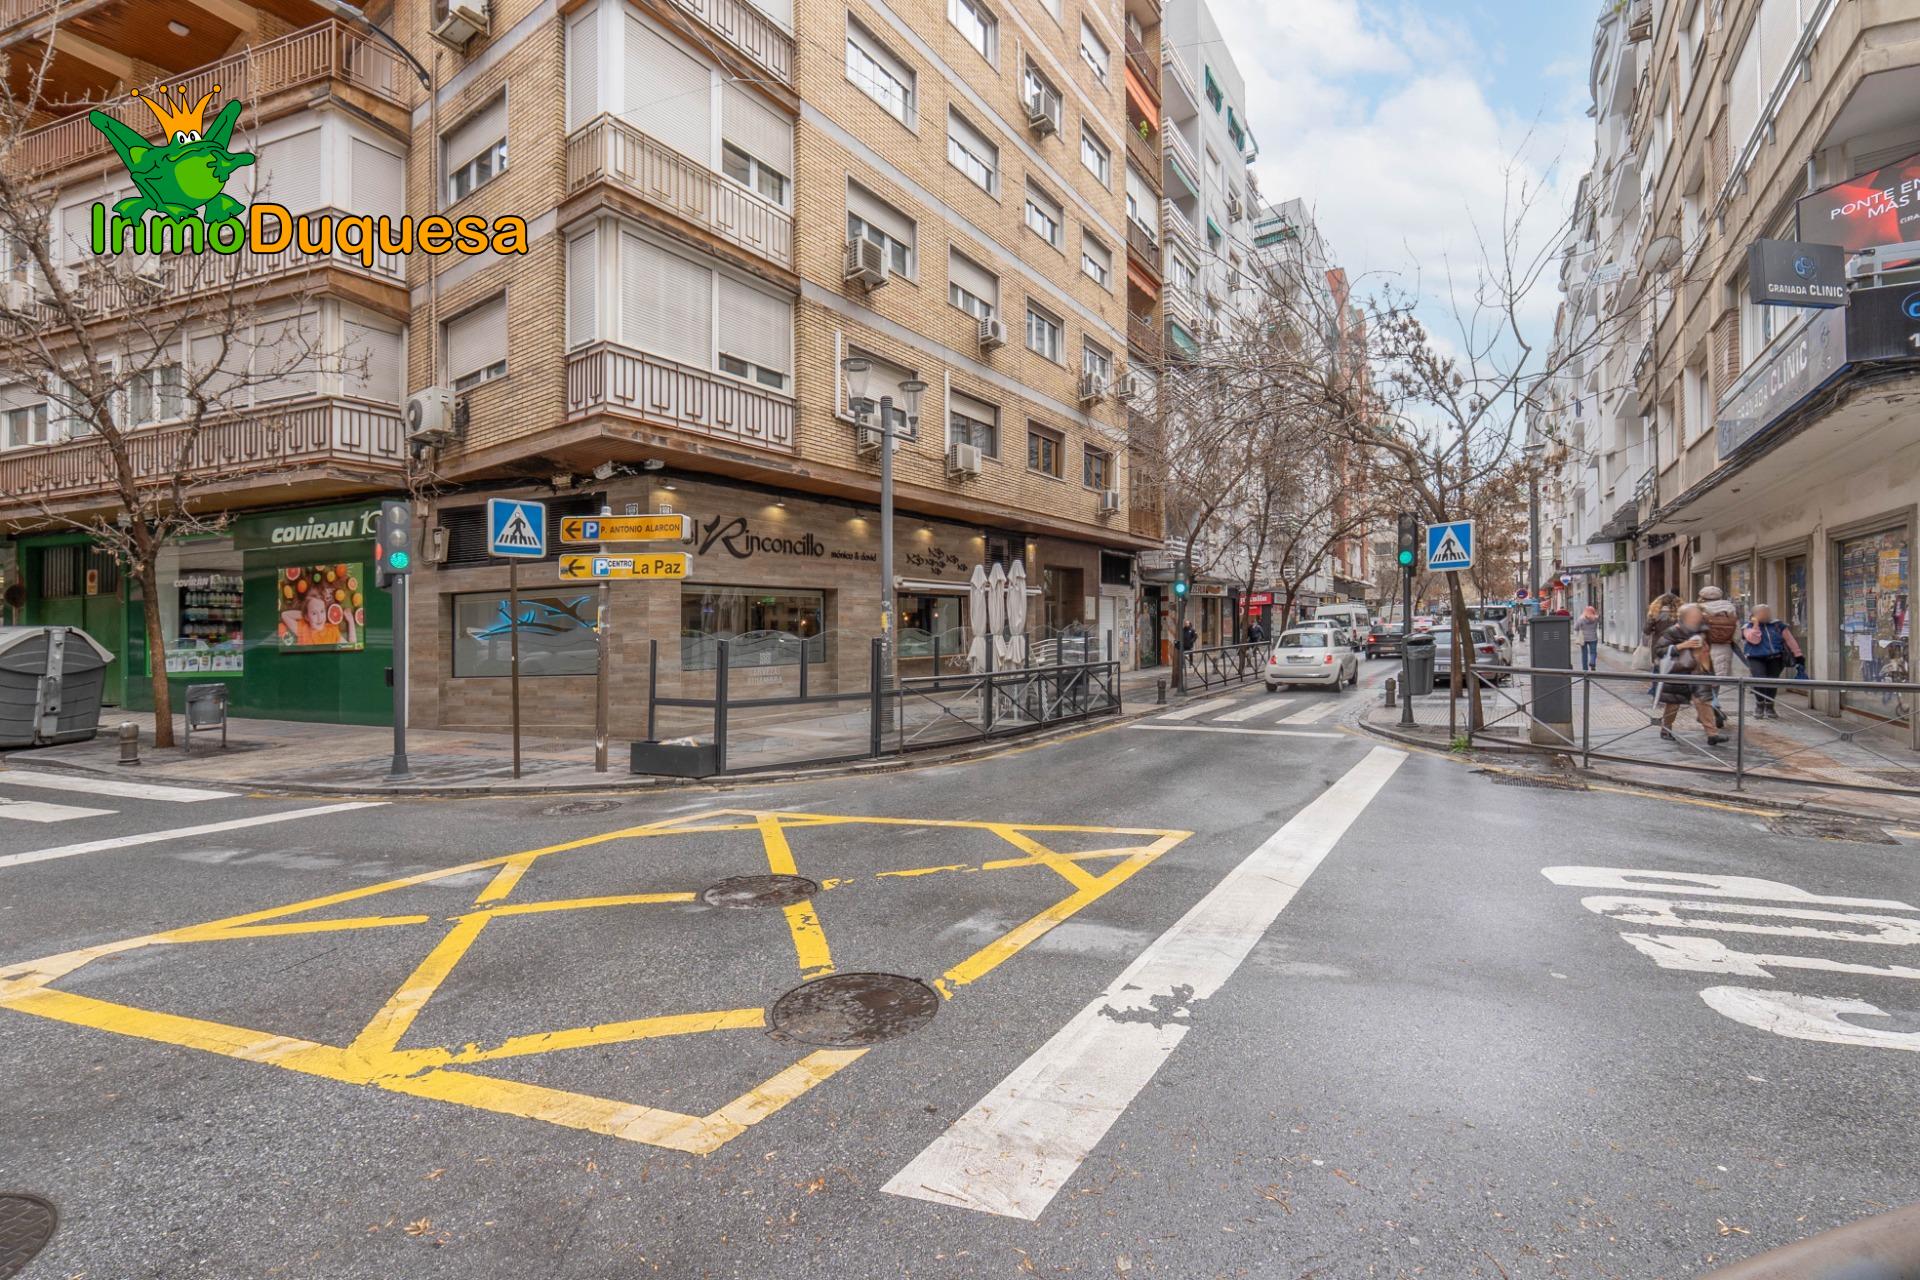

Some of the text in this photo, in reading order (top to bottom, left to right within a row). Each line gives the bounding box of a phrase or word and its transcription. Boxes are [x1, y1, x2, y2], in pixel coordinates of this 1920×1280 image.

[1830, 187, 1895, 220] PONTE
[1767, 283, 1844, 298] GRANADA CLINIC
[1769, 340, 1808, 396] CLINIC
[609, 524, 643, 534] ANTONIO
[644, 523, 680, 533] ALARCON
[607, 559, 633, 569] CENTRO
[632, 560, 650, 575] La
[654, 559, 681, 575] Paz
